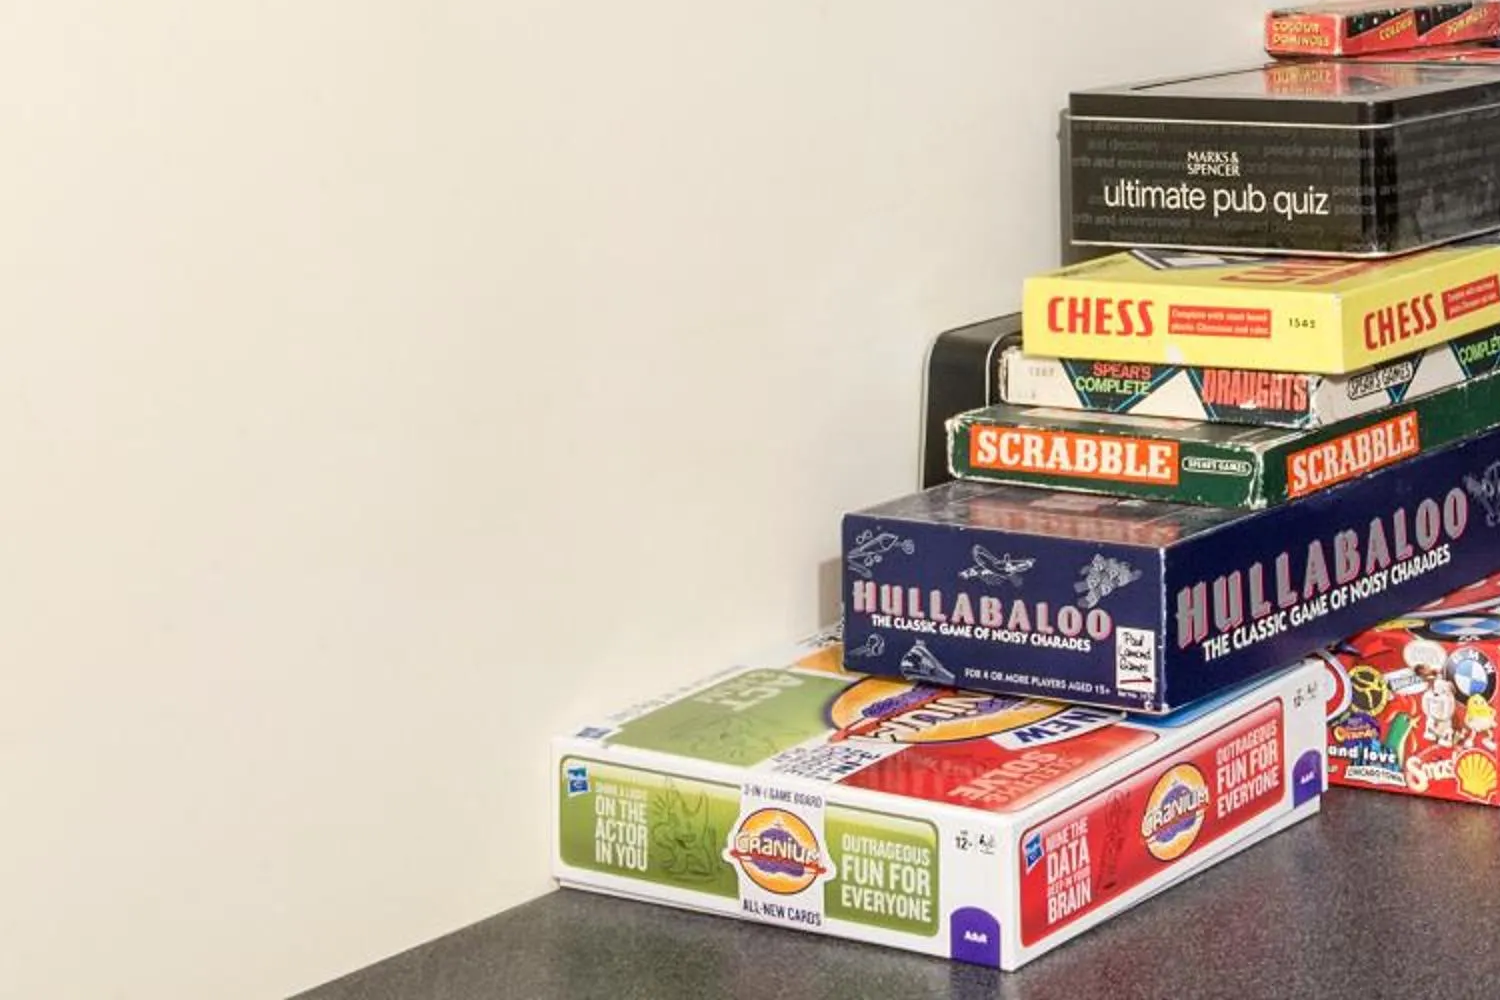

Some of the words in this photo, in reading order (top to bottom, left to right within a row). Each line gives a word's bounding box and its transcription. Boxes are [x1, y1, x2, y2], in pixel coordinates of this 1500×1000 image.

[1186, 151, 1228, 164] MARKS
[1186, 163, 1240, 177] SPENCER
[1104, 180, 1206, 210] ultimate
[1213, 183, 1266, 218] pub
[1273, 186, 1330, 220] quiz
[1048, 297, 1154, 338] CHESS
[1363, 294, 1439, 352] CHESS
[1075, 376, 1151, 397] COMPLETE
[1092, 362, 1152, 380] SPEAR'S
[1201, 369, 1311, 412] DRAUGHTS
[976, 430, 1174, 481] SCRABBLE
[1292, 415, 1418, 496] SCRABBLE
[1177, 486, 1468, 650] HULLABALOO
[852, 580, 1112, 641] HULLABALOO
[1203, 632, 1232, 663] THE
[1234, 612, 1287, 653] CLASSIC
[1291, 595, 1329, 628] GAME
[1331, 588, 1350, 611] OF
[1350, 573, 1389, 606] NOISY
[1390, 544, 1451, 585] CHARADES
[871, 613, 891, 628] THE
[892, 616, 936, 634] CLASSIC
[939, 623, 971, 639] GAME
[973, 626, 989, 640] OF
[991, 628, 1028, 646] NOISY
[1029, 632, 1092, 652] CHARADES
[964, 668, 981, 680] FOR
[1004, 673, 1029, 685] MORE
[1030, 676, 1066, 690] PLAYERS
[1068, 681, 1092, 693] AGED
[1014, 709, 1103, 744] NEW
[1216, 719, 1278, 765] OUTRAGEOUS
[1217, 757, 1247, 795] FUN
[1249, 739, 1278, 775] FOR
[1328, 744, 1360, 759] and
[1364, 748, 1395, 764] love
[595, 795, 619, 817] ON
[620, 799, 649, 826] THE
[1217, 767, 1280, 819] EVERYONE
[595, 818, 649, 848] ACTOR
[841, 833, 931, 867] OUTRAGEOUS
[595, 843, 613, 864] IN
[616, 846, 649, 873] YOU
[841, 854, 884, 888] FUN
[889, 863, 931, 898] FOR
[1047, 839, 1090, 880] DATA
[742, 898, 786, 921] ALL-NEW
[787, 906, 822, 927] CARDS
[841, 887, 932, 923] EVERYONE
[1047, 885, 1092, 925] BRAIN
